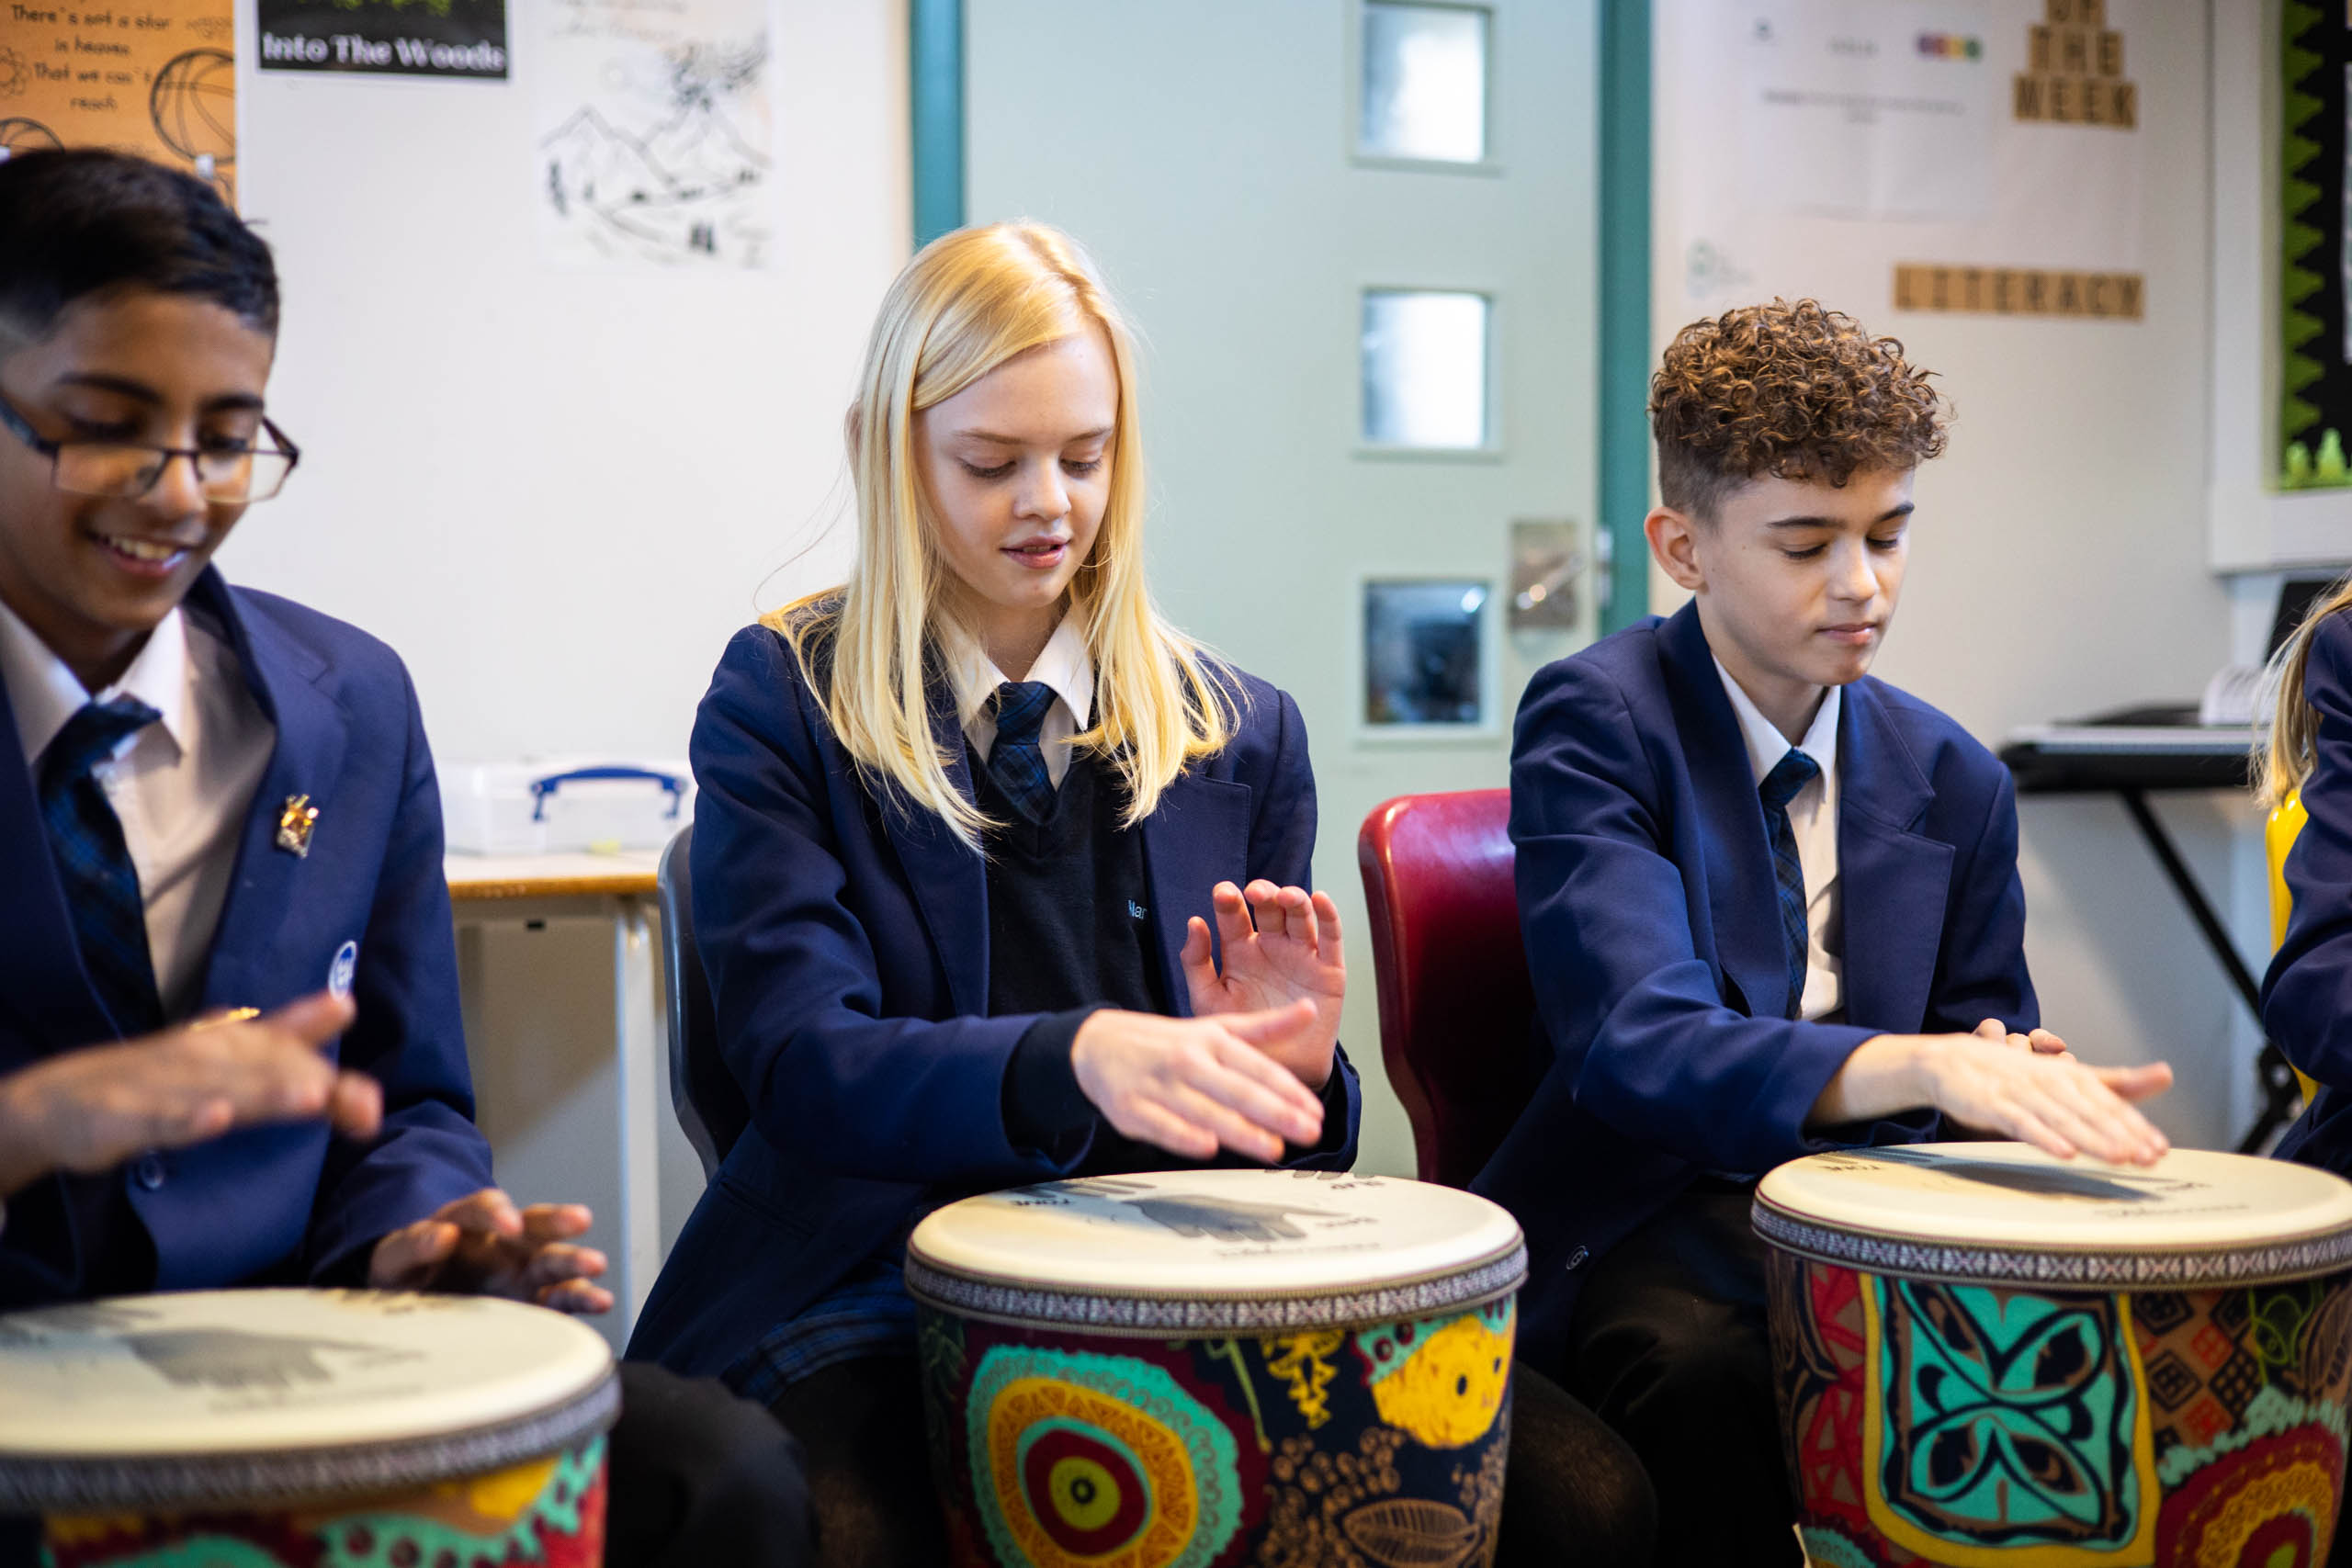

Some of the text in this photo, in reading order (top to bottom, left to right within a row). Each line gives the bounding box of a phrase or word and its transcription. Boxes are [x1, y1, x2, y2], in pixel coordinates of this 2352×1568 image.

[34, 62, 70, 79] That
[78, 71, 99, 82] we
[263, 32, 505, 72] Into The Woods
[2033, 27, 2120, 75] THE
[2016, 76, 2136, 128] WEEK
[1895, 266, 2142, 316] LITERACY
